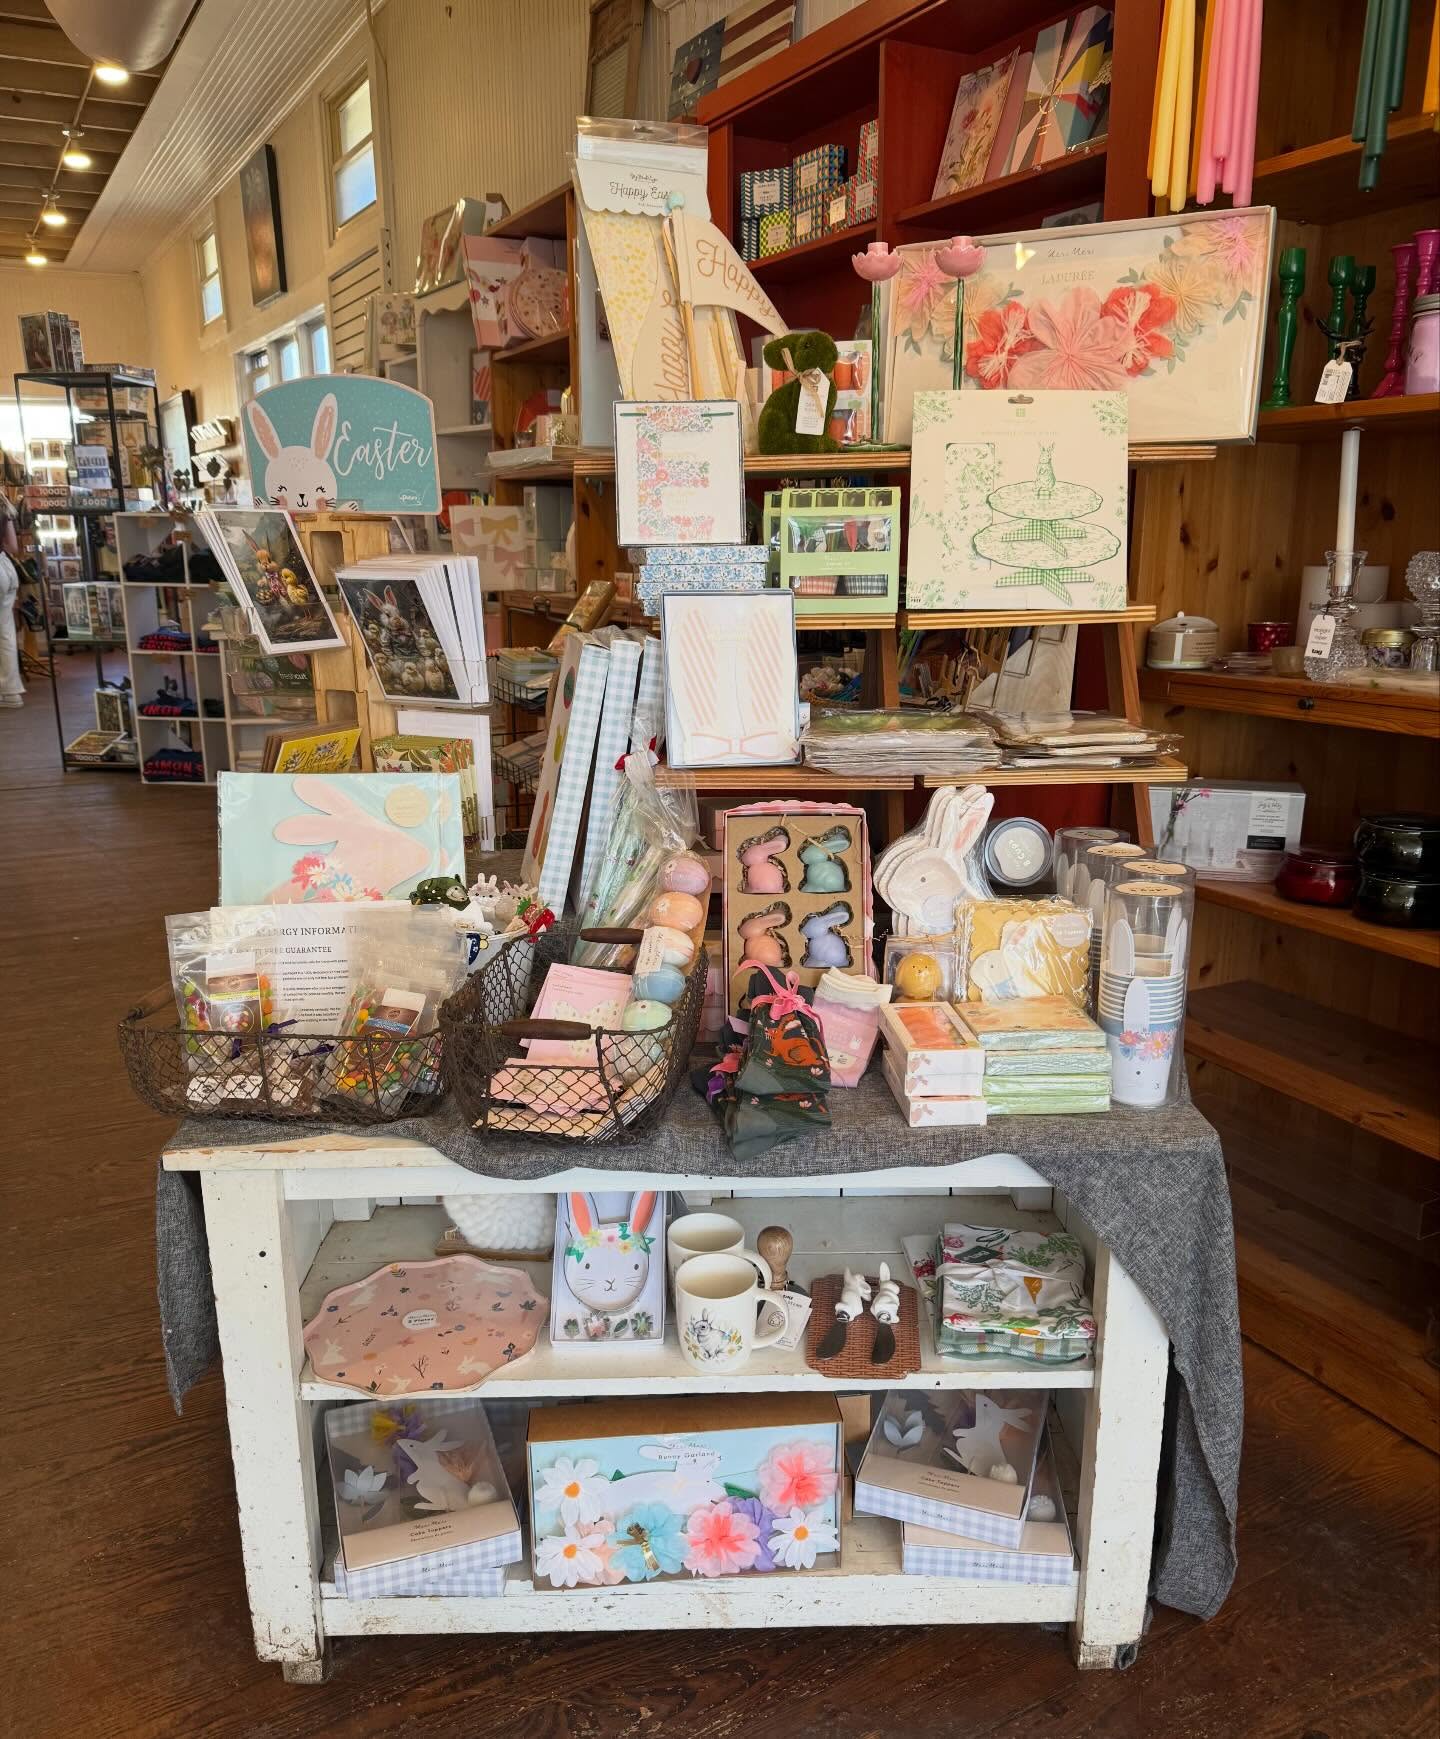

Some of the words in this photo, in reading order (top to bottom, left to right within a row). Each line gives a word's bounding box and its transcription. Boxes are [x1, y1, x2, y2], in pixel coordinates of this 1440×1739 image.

[609, 182, 648, 201] Happy
[695, 239, 776, 319] Happy
[333, 420, 432, 480] Easter
[285, 946, 332, 954] GUARANTEE
[684, 1450, 716, 1458] Garland
[427, 1524, 453, 1534] Toppers
